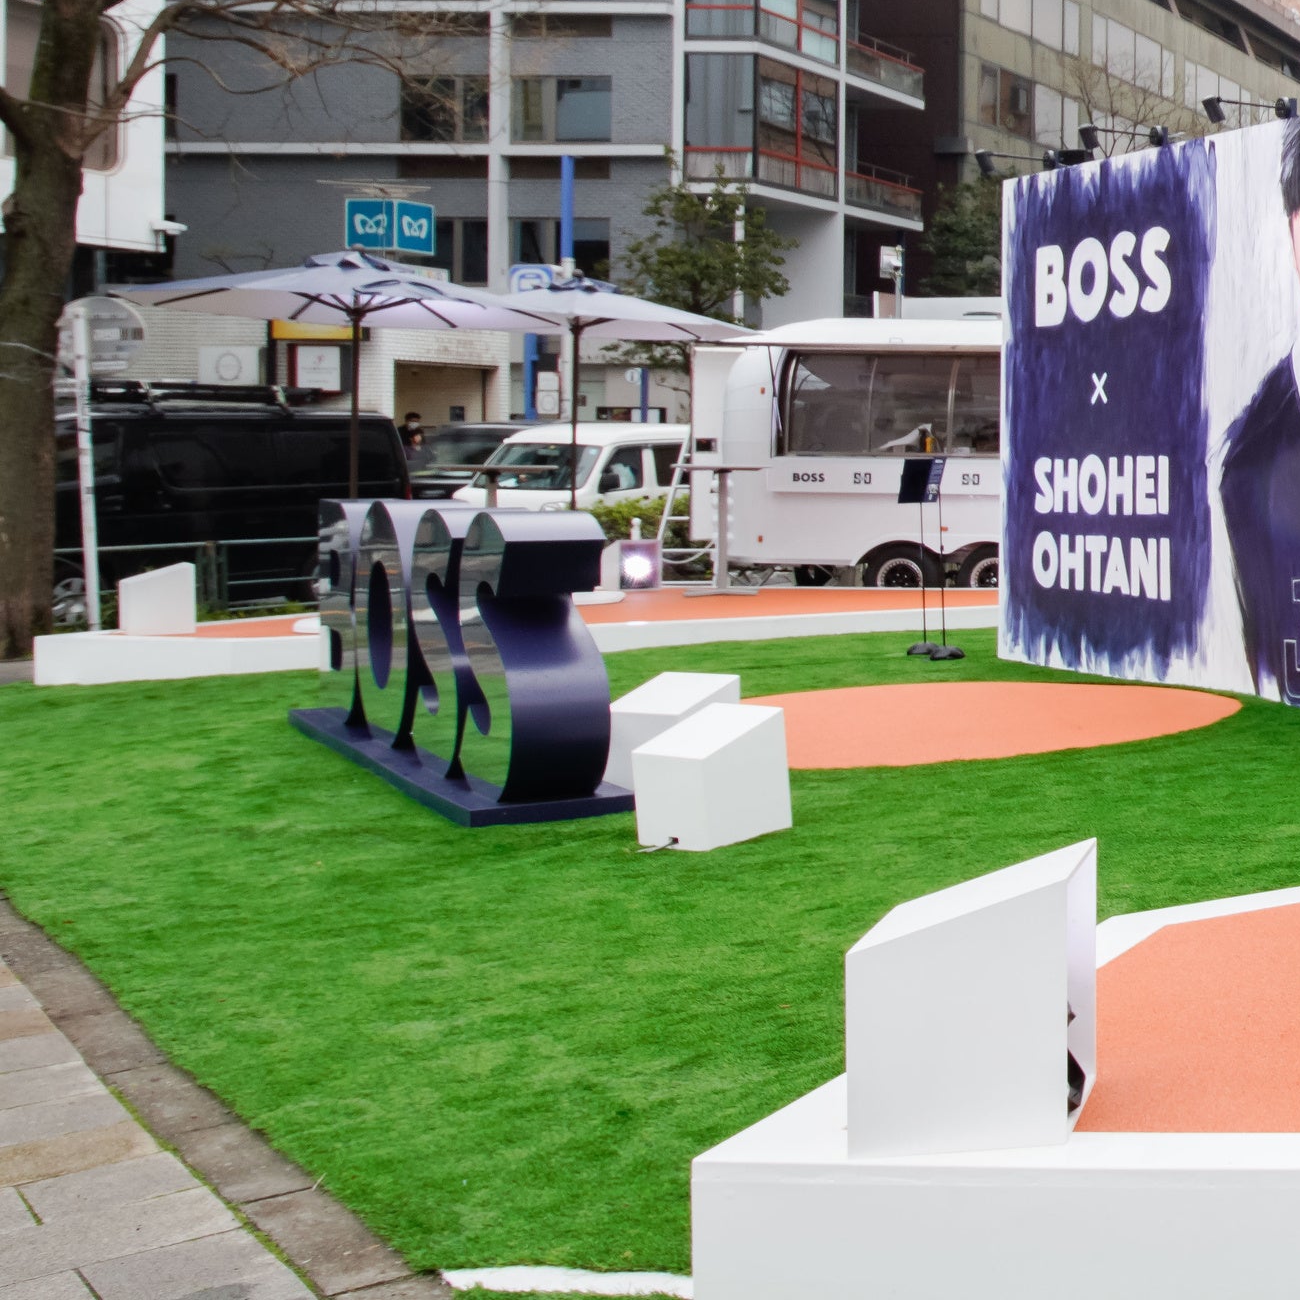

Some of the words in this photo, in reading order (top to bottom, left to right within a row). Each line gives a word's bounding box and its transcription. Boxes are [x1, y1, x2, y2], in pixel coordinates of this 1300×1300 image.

[1035, 226, 1172, 328] BOSS
[792, 472, 825, 483] BOSS
[1034, 454, 1170, 516] SHOHEI
[1032, 530, 1171, 601] OHTANI
